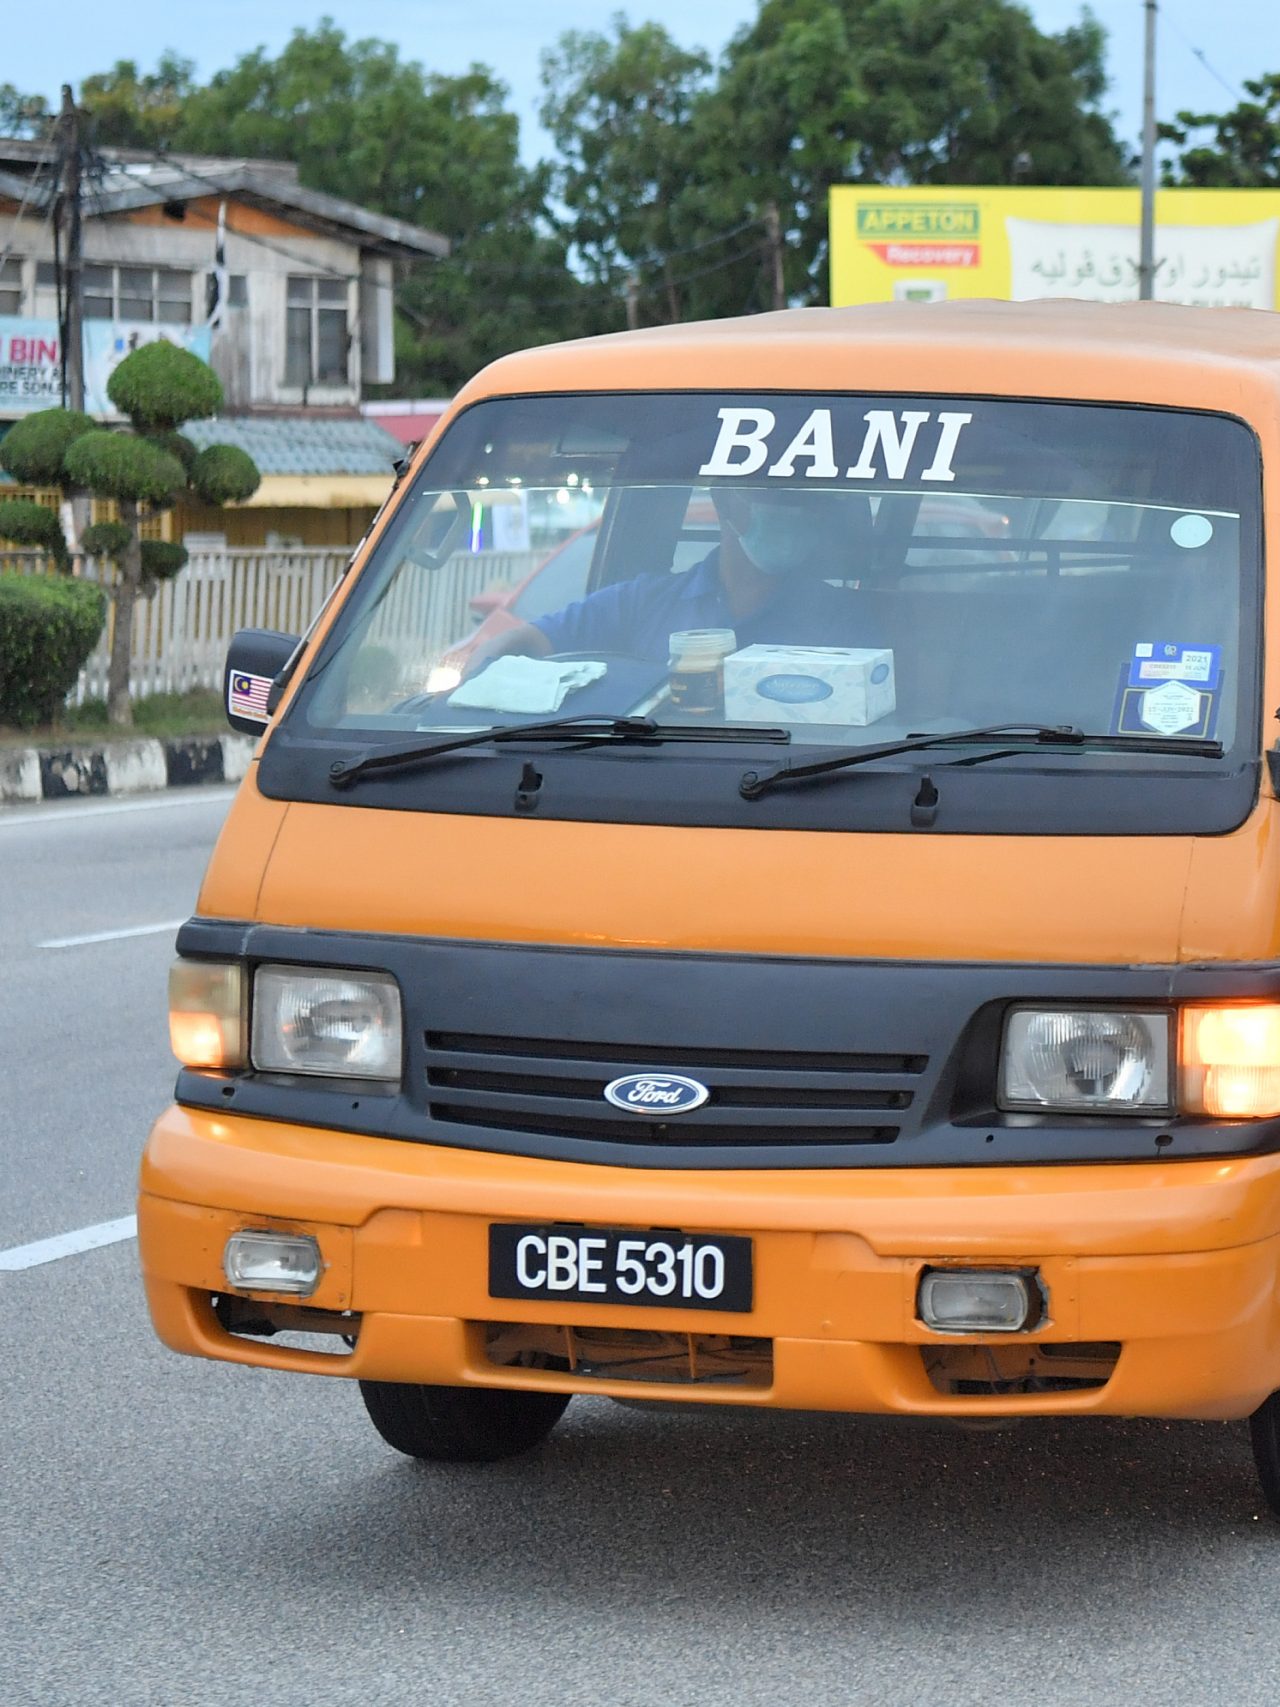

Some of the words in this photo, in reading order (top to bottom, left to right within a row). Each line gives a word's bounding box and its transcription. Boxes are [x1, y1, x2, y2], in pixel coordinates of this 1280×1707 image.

[864, 208, 975, 232] APPETON
[885, 244, 974, 267] Recovery
[11, 338, 58, 363] BIN
[698, 407, 973, 482] BANI
[627, 1081, 684, 1104] Ford
[516, 1235, 607, 1293] CBE
[616, 1240, 725, 1299] 5310
